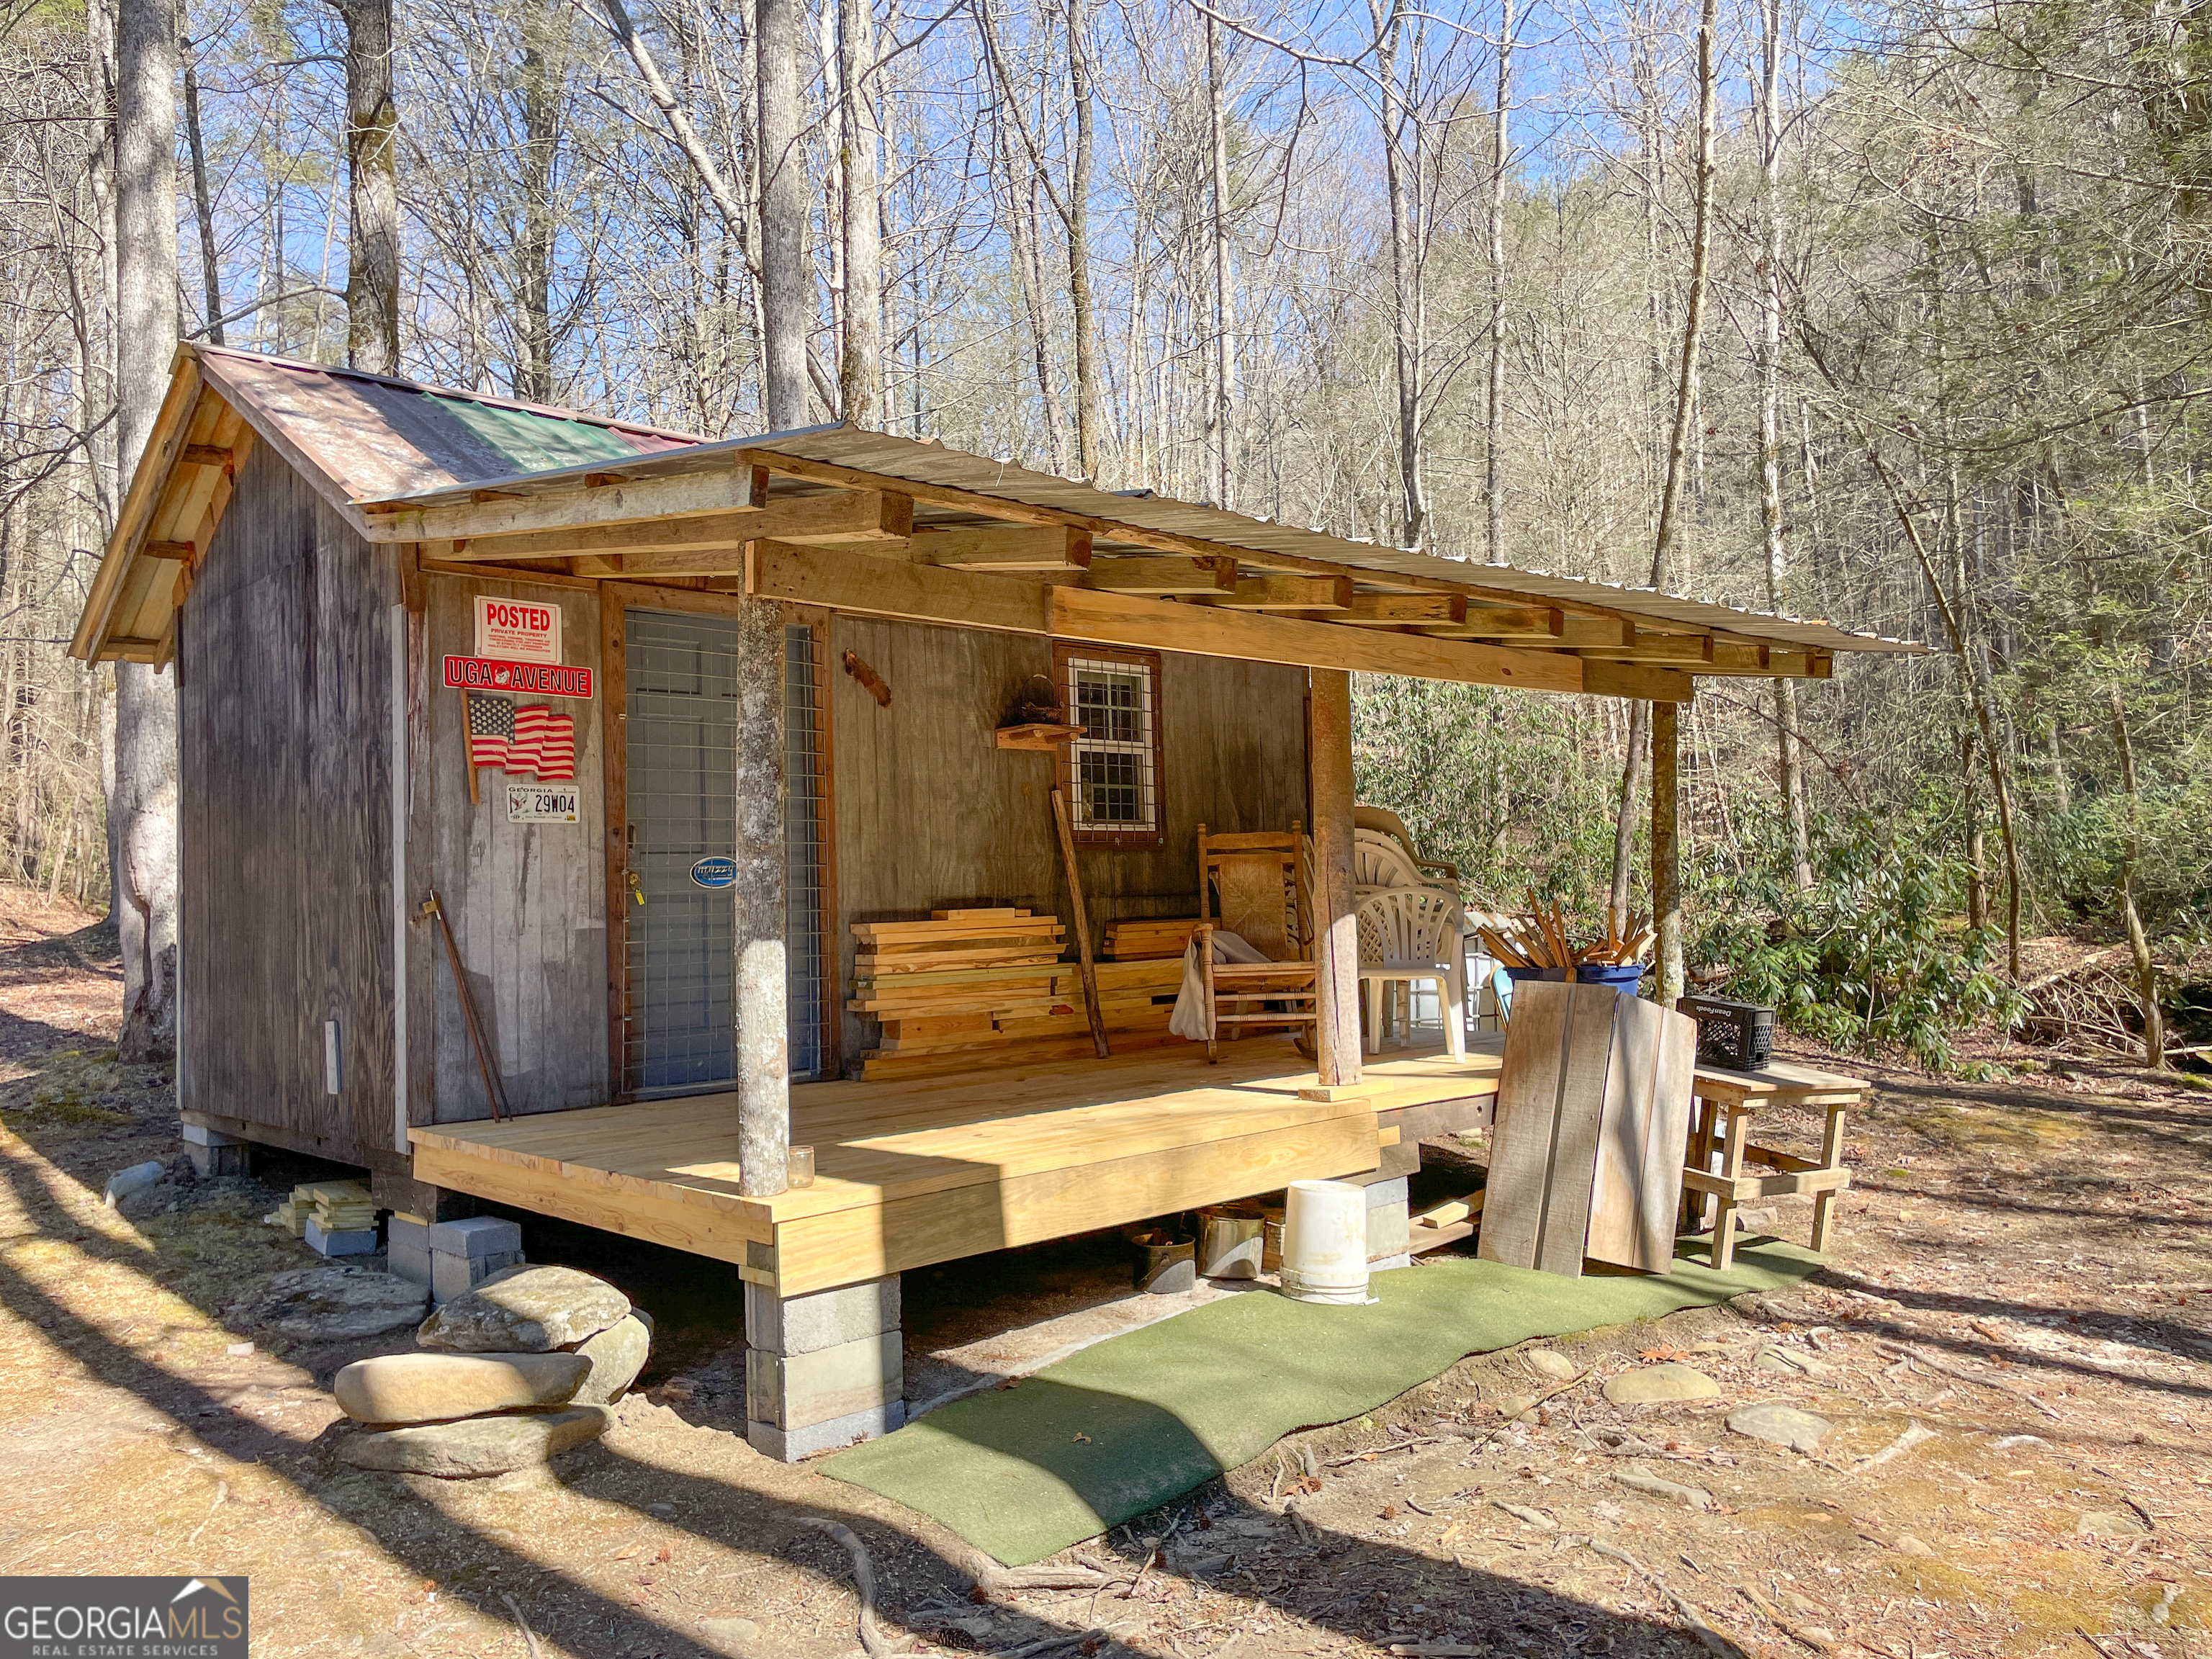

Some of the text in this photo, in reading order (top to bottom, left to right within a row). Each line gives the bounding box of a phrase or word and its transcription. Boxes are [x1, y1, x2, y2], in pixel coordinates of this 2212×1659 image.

[487, 603, 550, 631] POSTED
[449, 660, 588, 694] UGA AVENUE
[535, 794, 575, 813] 29W04
